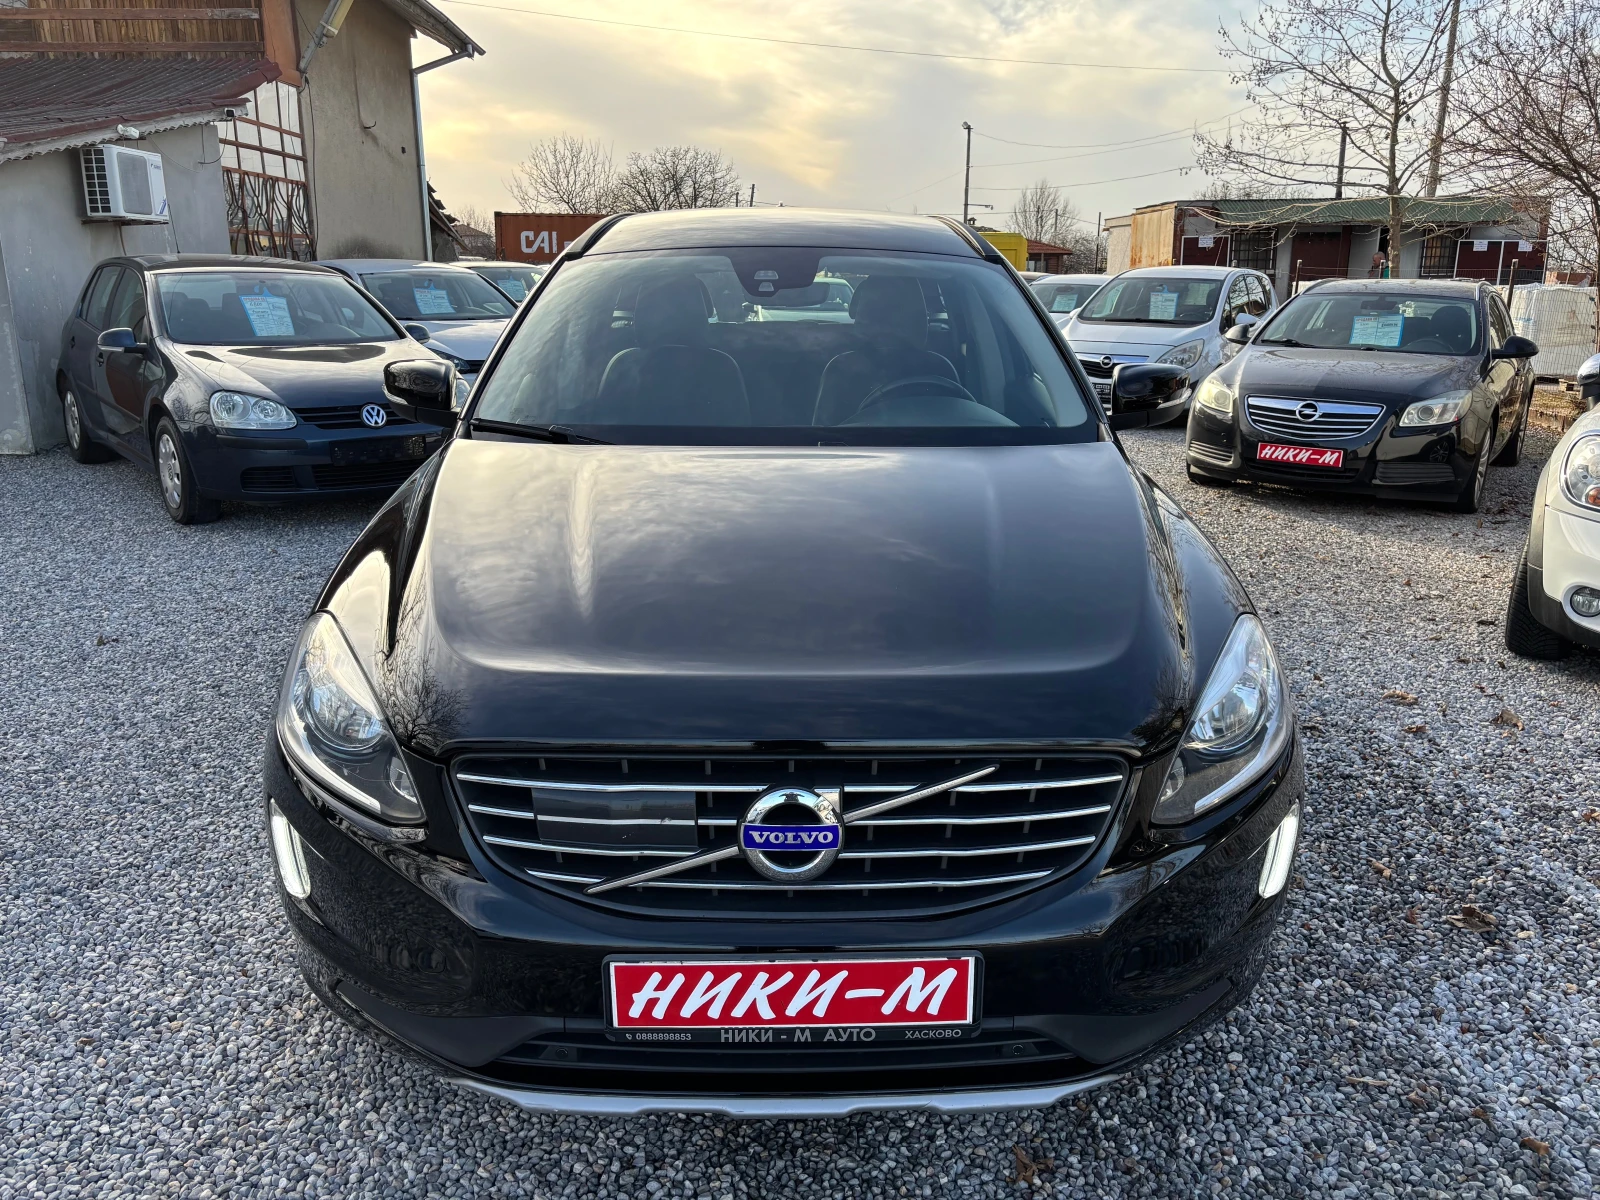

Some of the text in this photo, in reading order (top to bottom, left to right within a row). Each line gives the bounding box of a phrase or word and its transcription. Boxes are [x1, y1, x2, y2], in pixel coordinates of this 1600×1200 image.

[520, 230, 558, 254] CAI
[1260, 445, 1340, 466] НИКИ-М
[748, 830, 834, 844] VOLVO
[628, 966, 958, 1020] НИКИ-М
[635, 1032, 692, 1041] 0888898853
[720, 1029, 773, 1043] НИКИ
[793, 1028, 812, 1042] М
[823, 1027, 876, 1042] АУТО
[904, 1029, 962, 1039] ХАСКОВО
